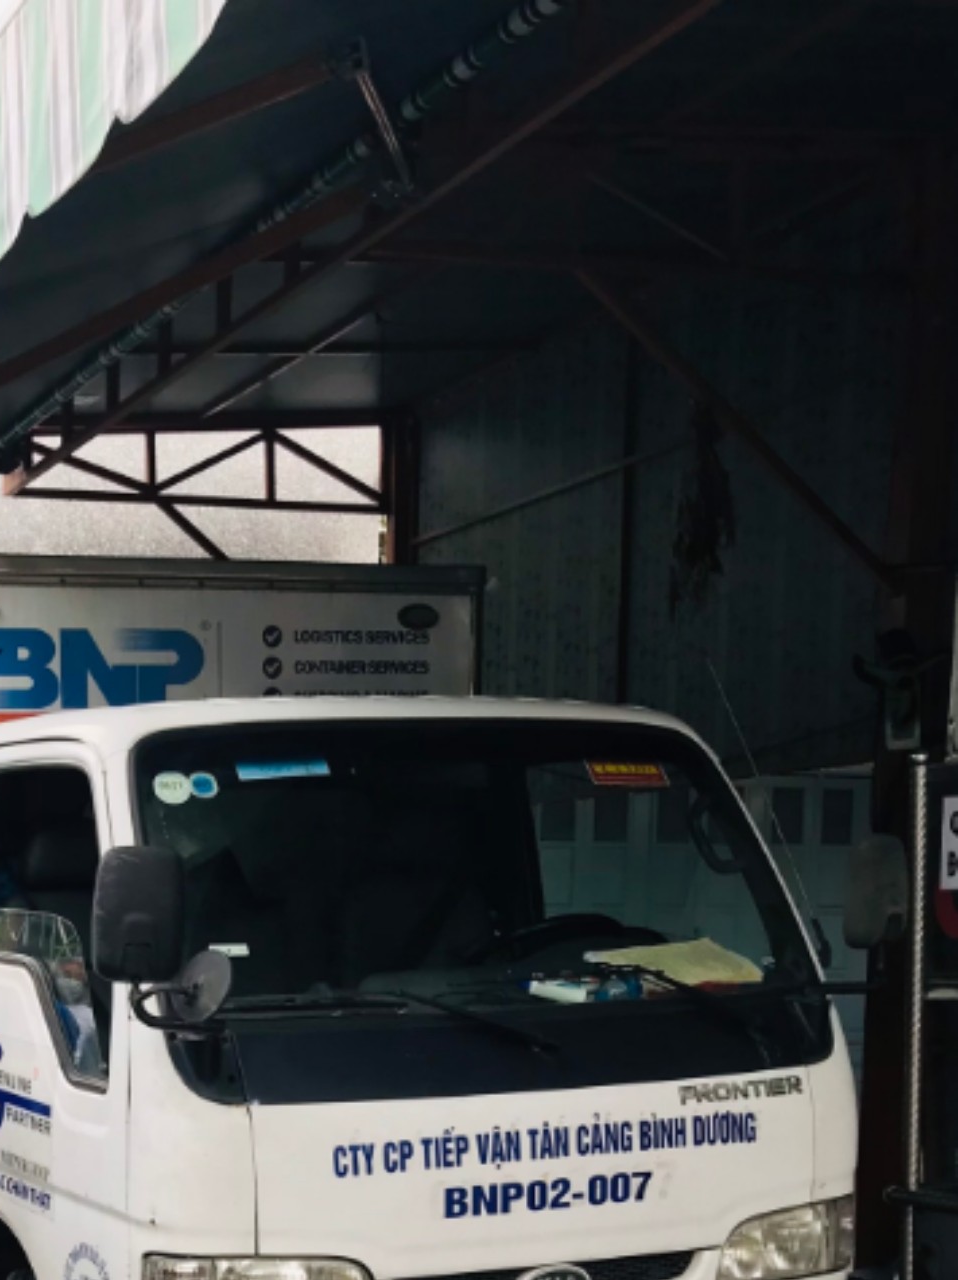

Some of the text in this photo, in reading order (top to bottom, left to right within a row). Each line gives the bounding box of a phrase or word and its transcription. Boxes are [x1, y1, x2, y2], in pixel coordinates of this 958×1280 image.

[294, 630, 430, 645] LOGISTICS SERVICES
[295, 660, 430, 674] CONTAINER SERVICES
[677, 1074, 803, 1106] FRONTIER
[333, 1110, 757, 1178] CTY CP TIẾP VẬN TÂN CẢNG BÌNH DƯƠNG
[444, 1171, 653, 1219] BNP02-007
